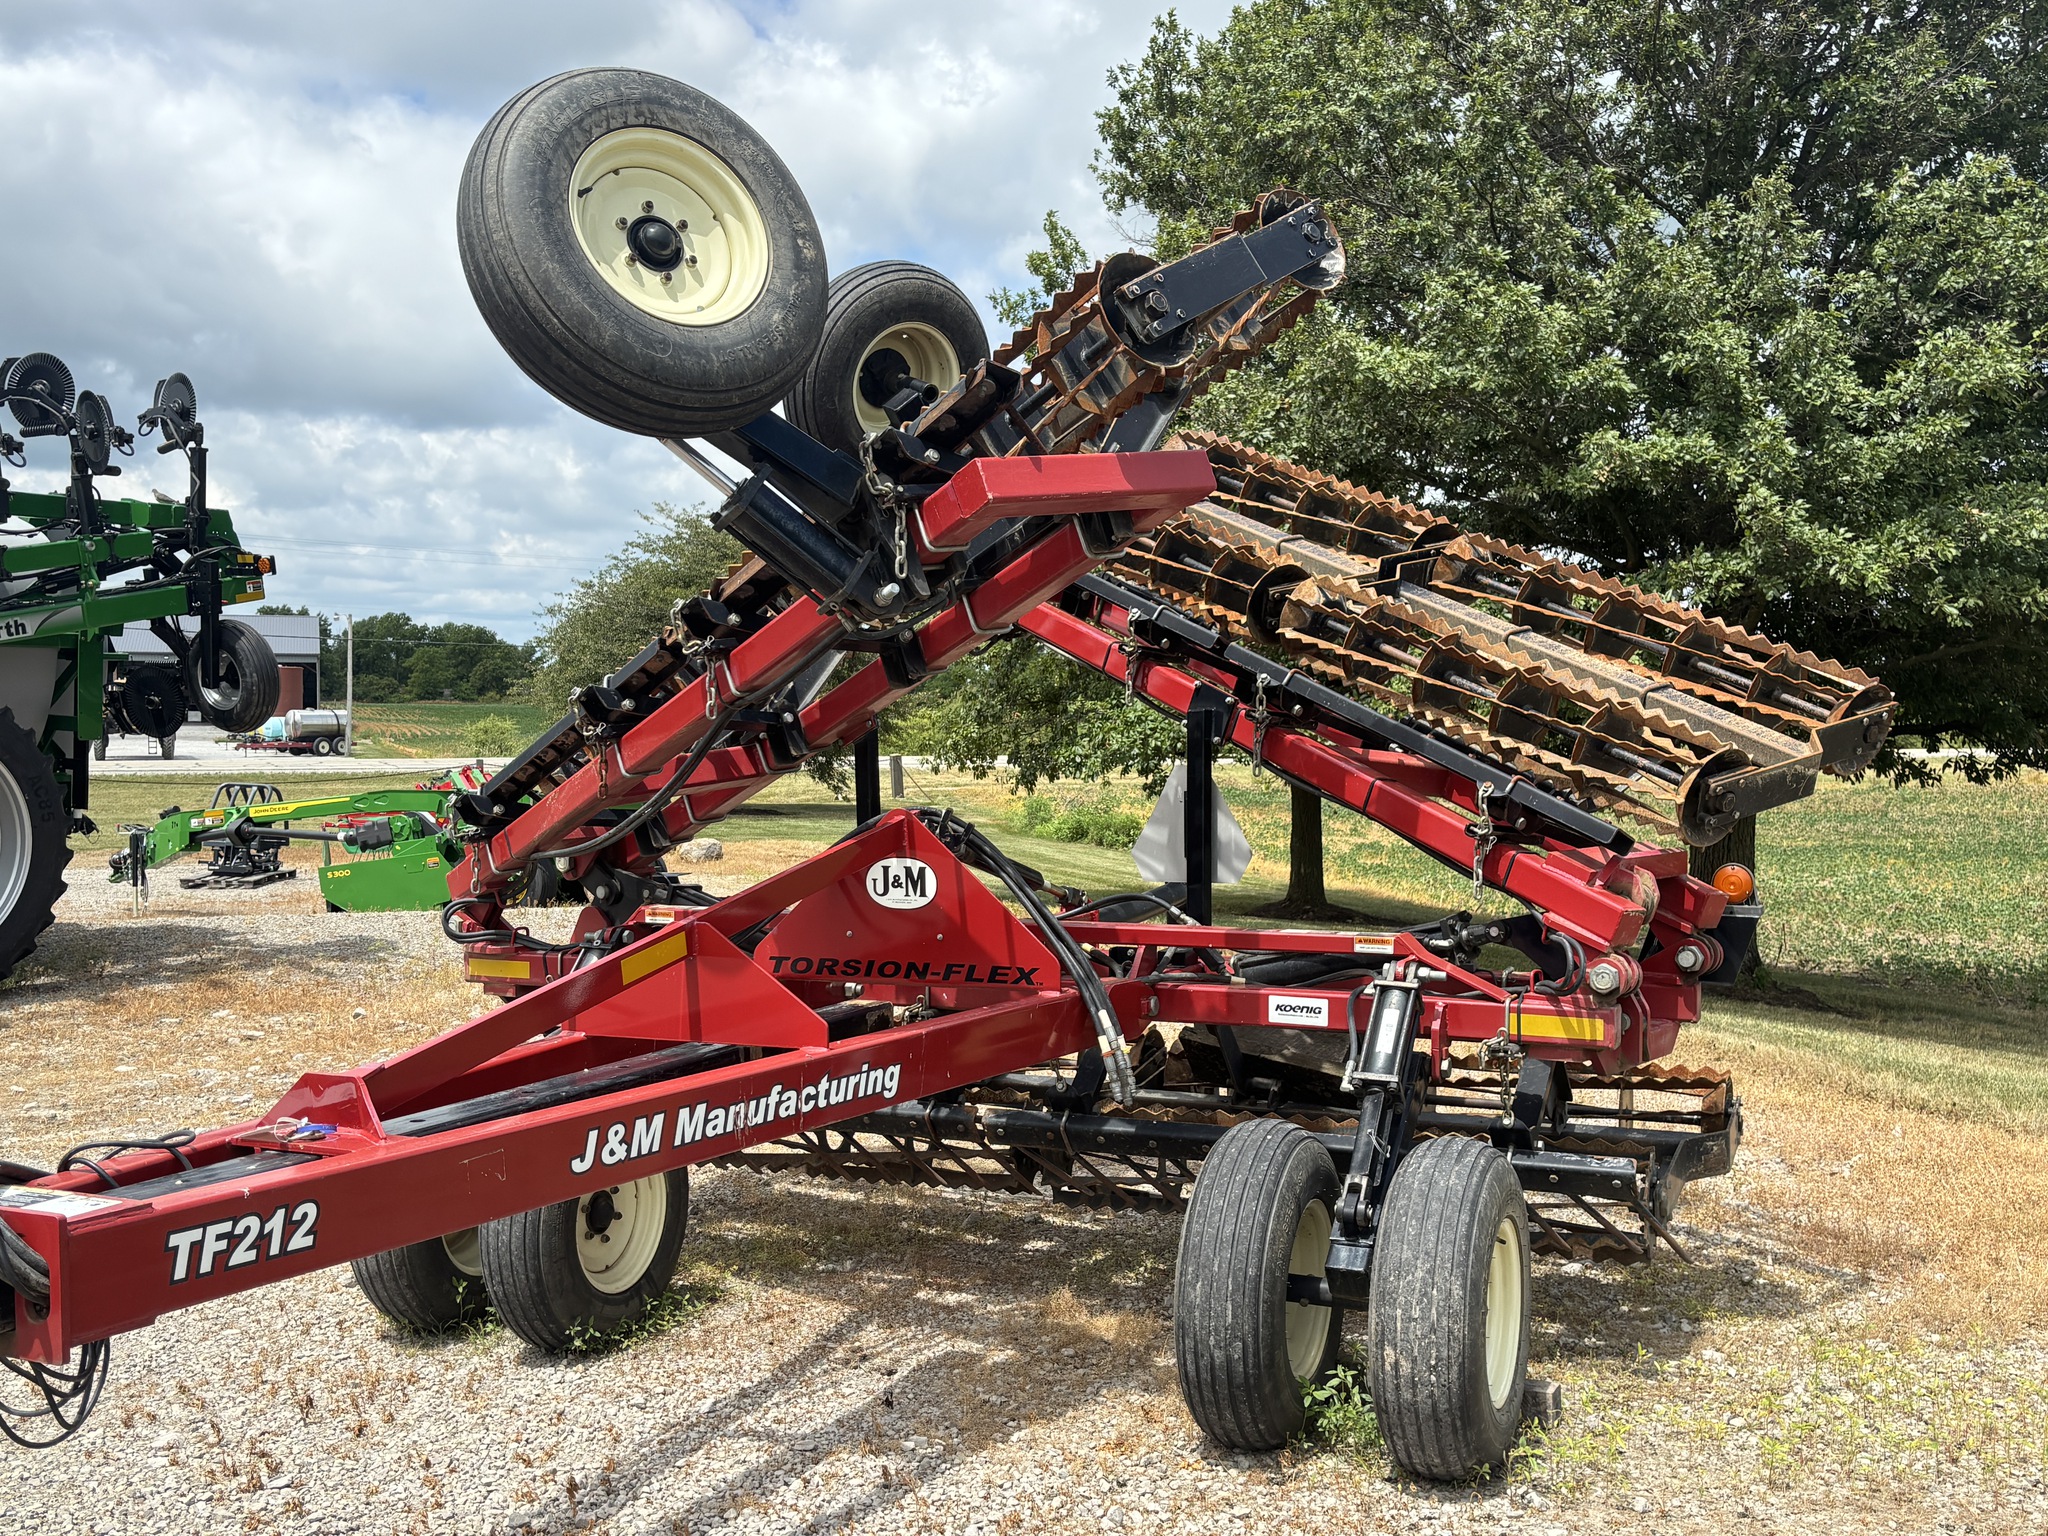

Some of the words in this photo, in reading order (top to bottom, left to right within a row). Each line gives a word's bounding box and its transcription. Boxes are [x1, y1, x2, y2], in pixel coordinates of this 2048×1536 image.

[534, 86, 642, 164] CARLISLE
[327, 869, 351, 879] S300
[871, 865, 928, 898] J&M
[768, 956, 1041, 986] TORSION-FLEX
[570, 1112, 665, 1174] J&M
[673, 1062, 902, 1148] Manufacturing
[166, 1200, 319, 1283] TF212
